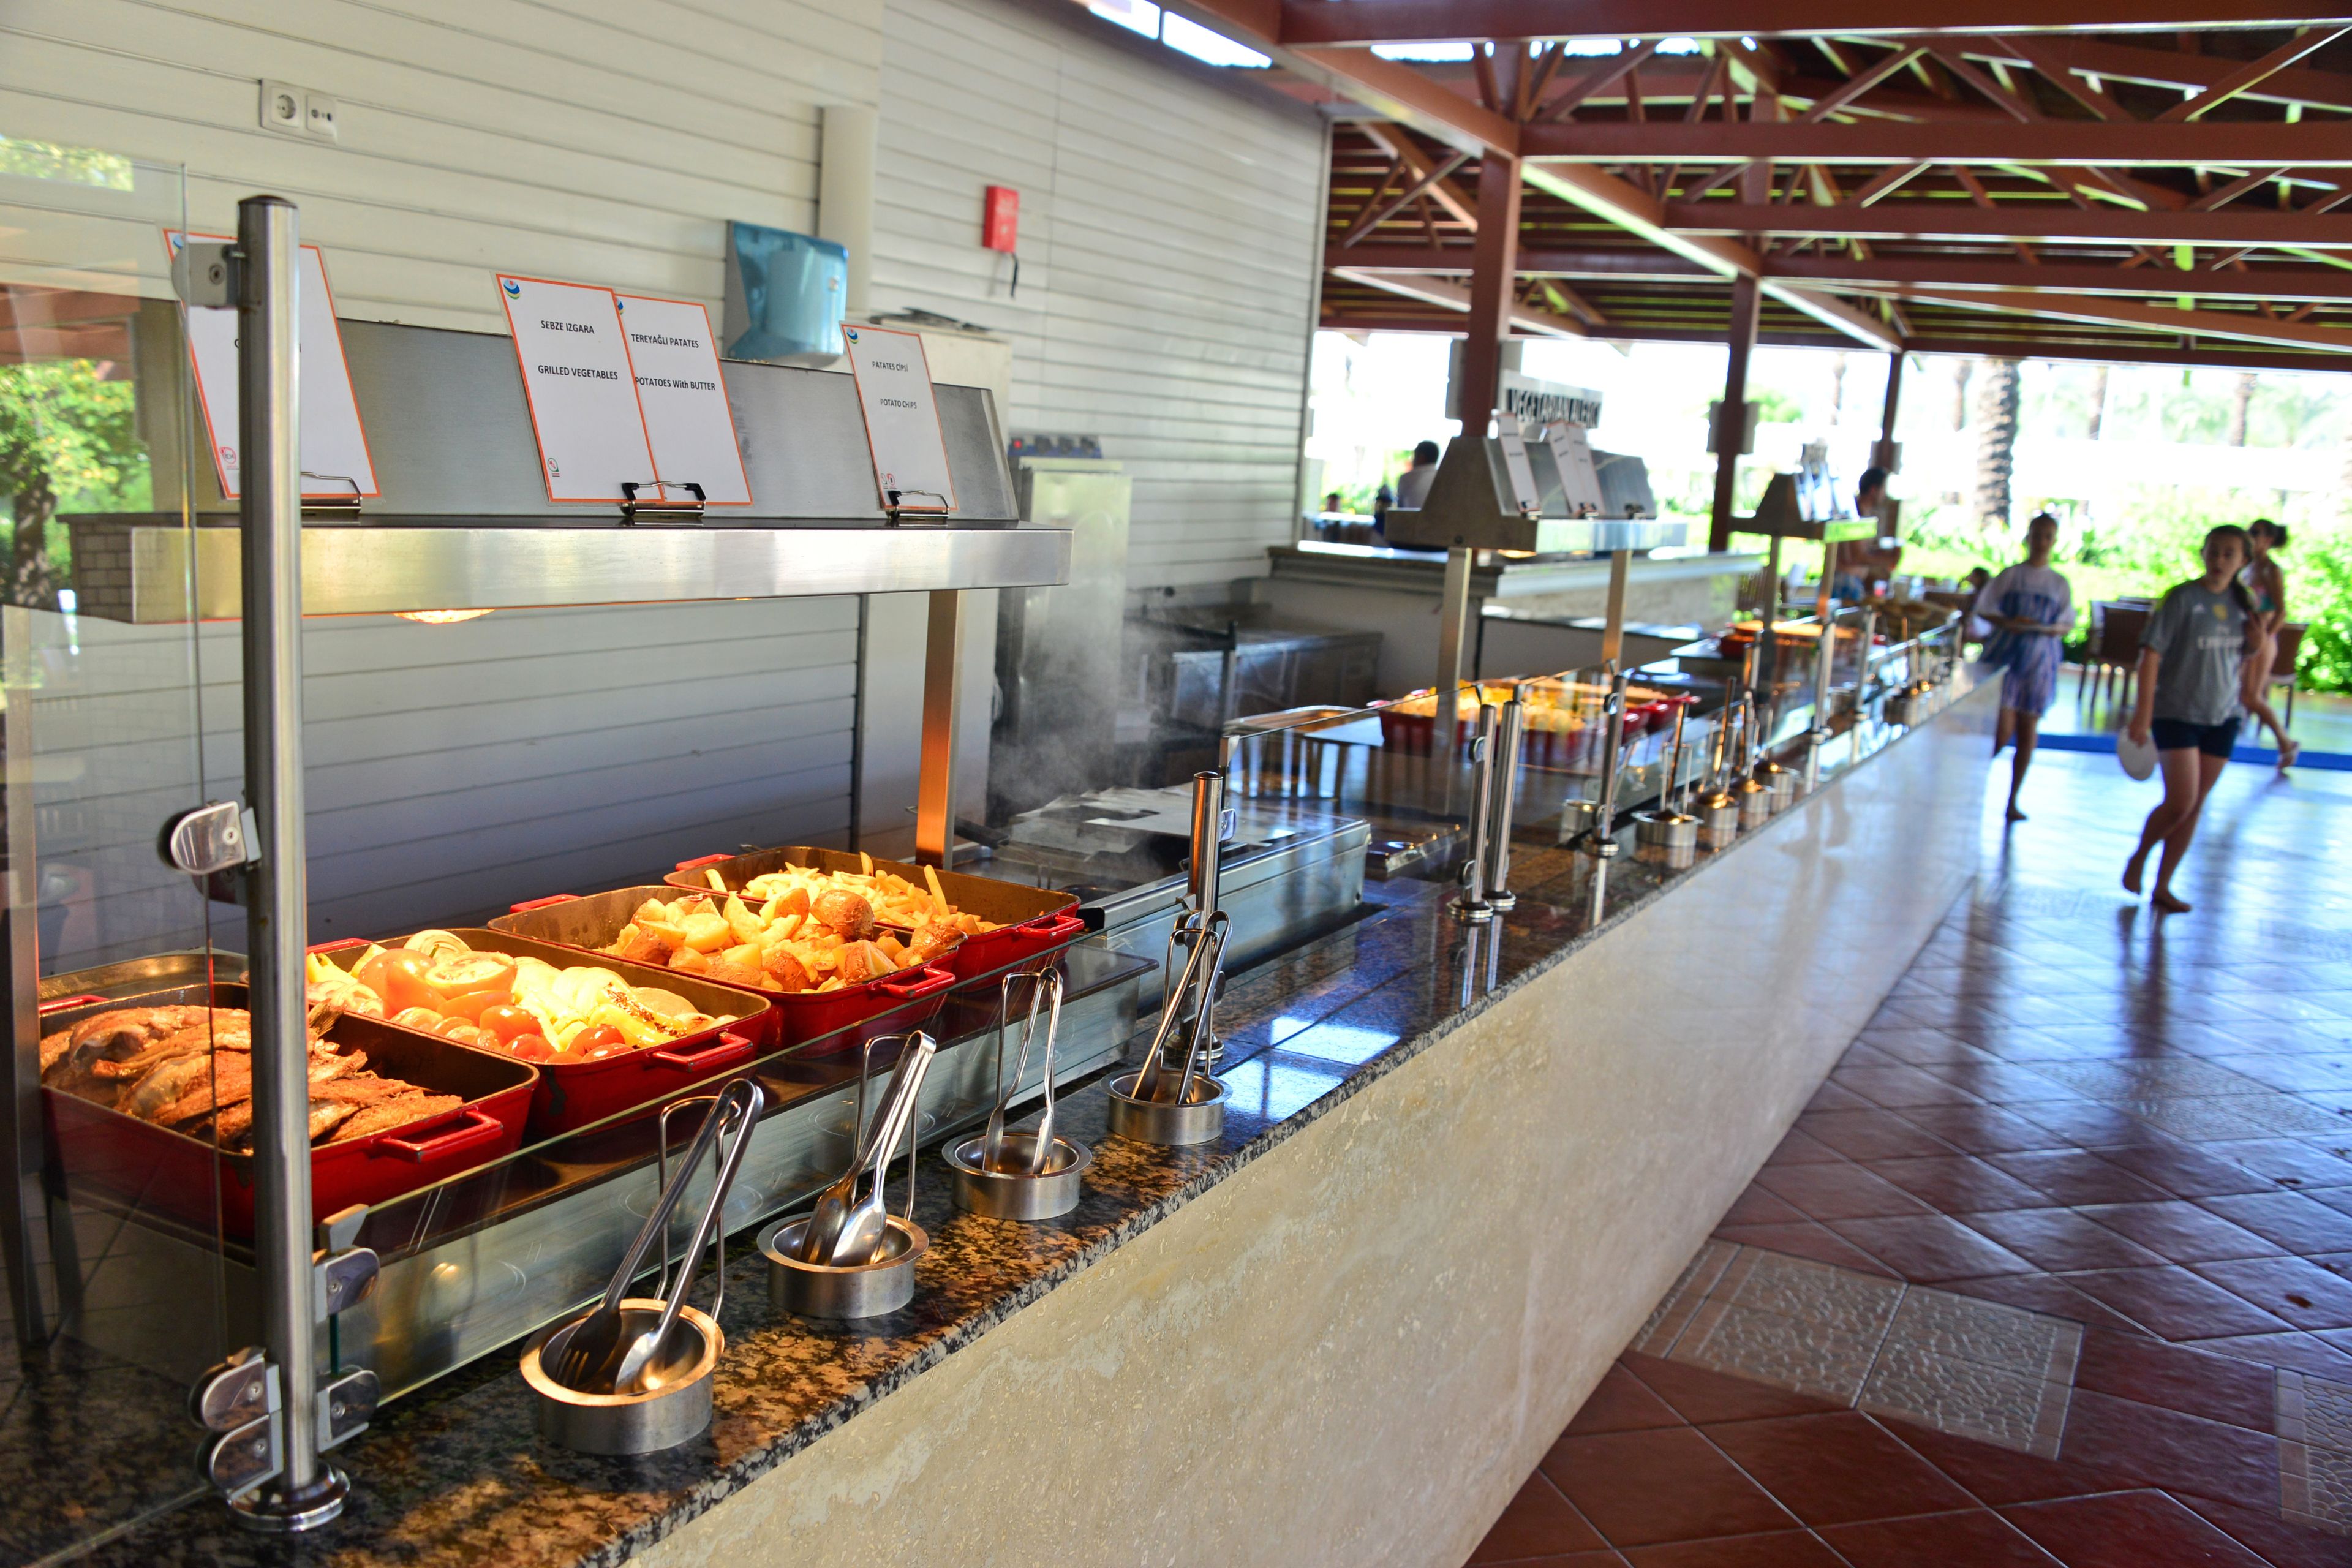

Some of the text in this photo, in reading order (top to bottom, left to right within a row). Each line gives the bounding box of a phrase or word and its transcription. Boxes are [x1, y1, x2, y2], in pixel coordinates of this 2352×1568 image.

[541, 320, 595, 334] SEBZE IZGARA
[631, 333, 699, 349] TEREYAĞLI PATATES
[538, 365, 618, 380] GRILLED VEGETABLES
[872, 361, 895, 370] PATATES
[635, 377, 716, 391] POTATOES With BUTTER
[880, 399, 901, 407] POTATO
